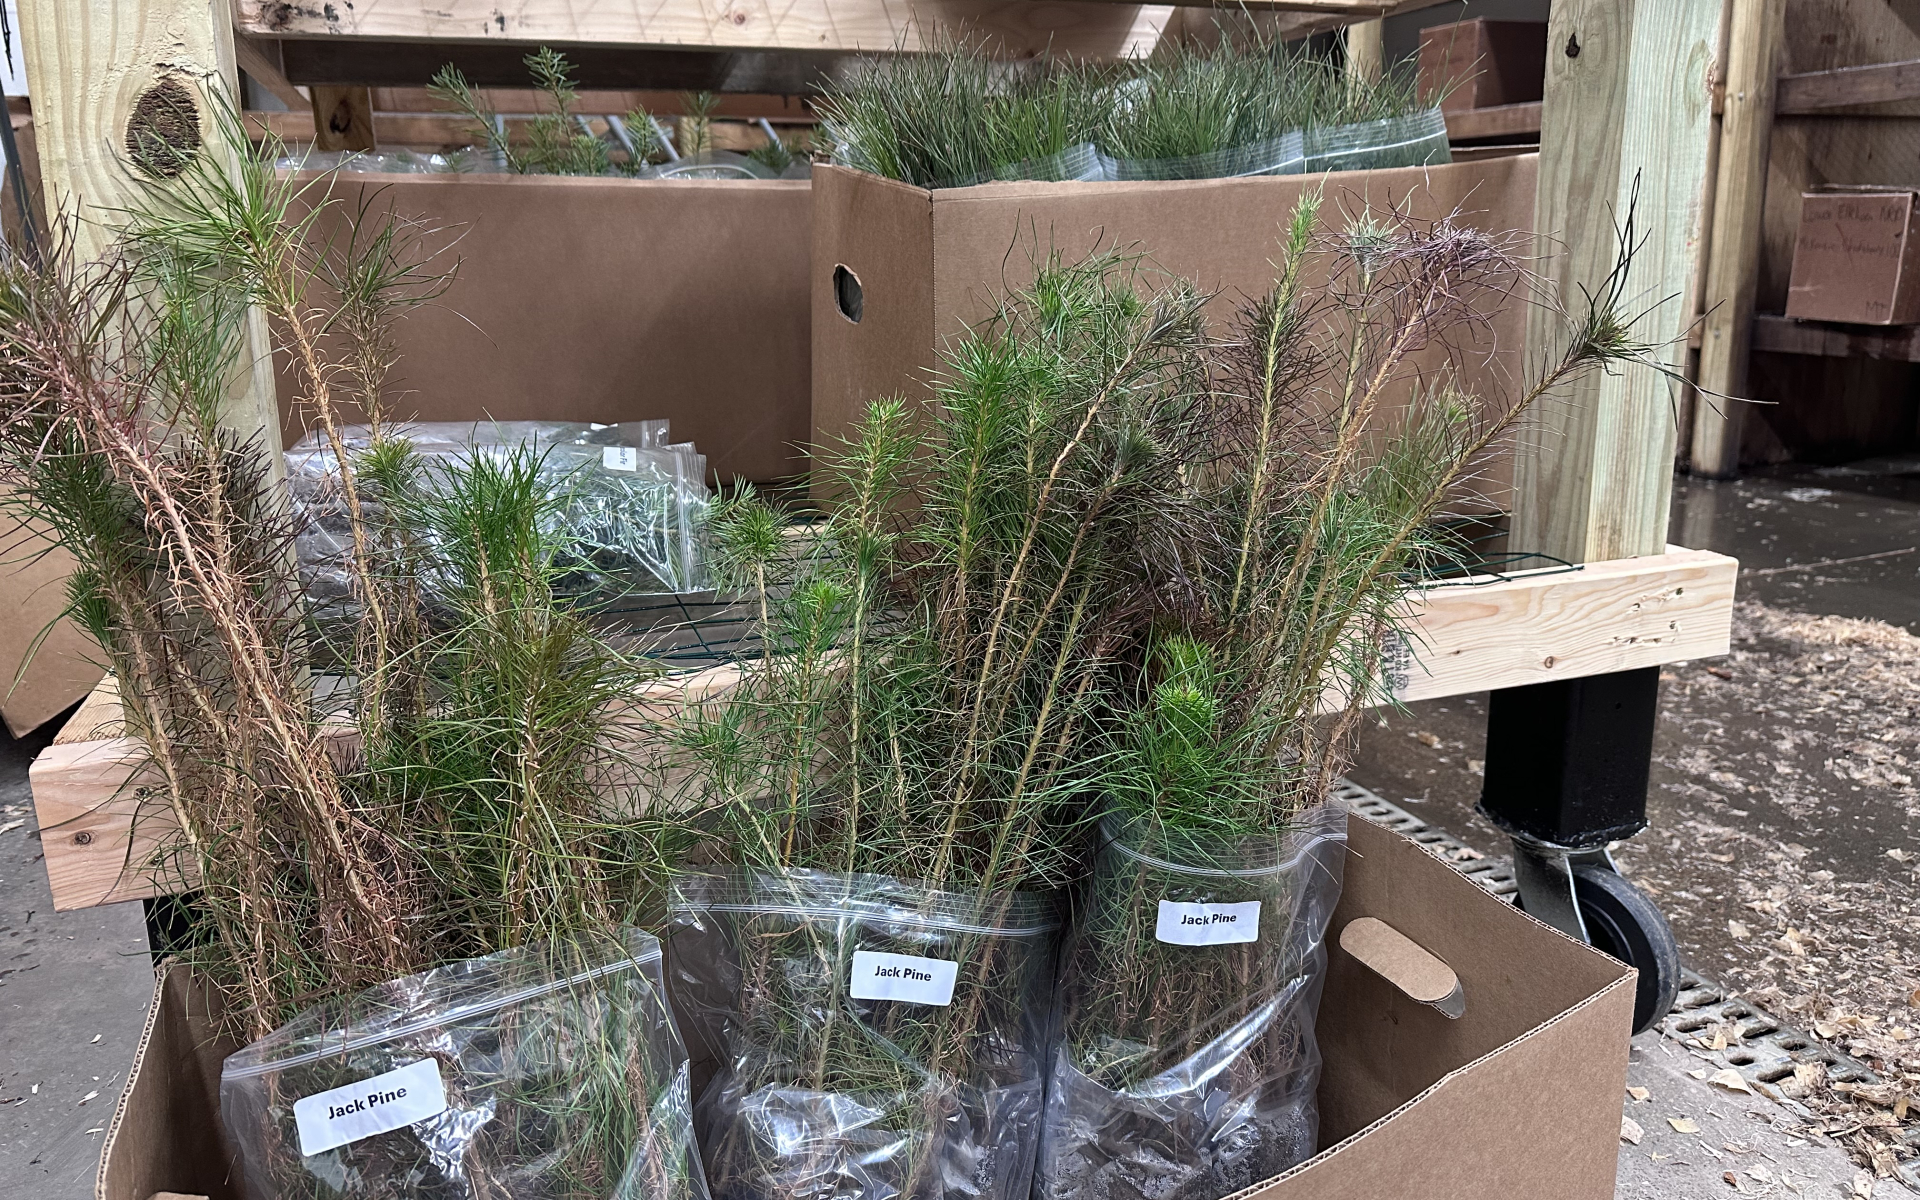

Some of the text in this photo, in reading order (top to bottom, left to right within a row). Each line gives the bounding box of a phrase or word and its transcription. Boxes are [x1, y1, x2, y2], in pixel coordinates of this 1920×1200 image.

[1181, 913, 1237, 925] Jack Pine
[874, 965, 932, 981] Jack Pine
[328, 1087, 407, 1120] Jack Pine
